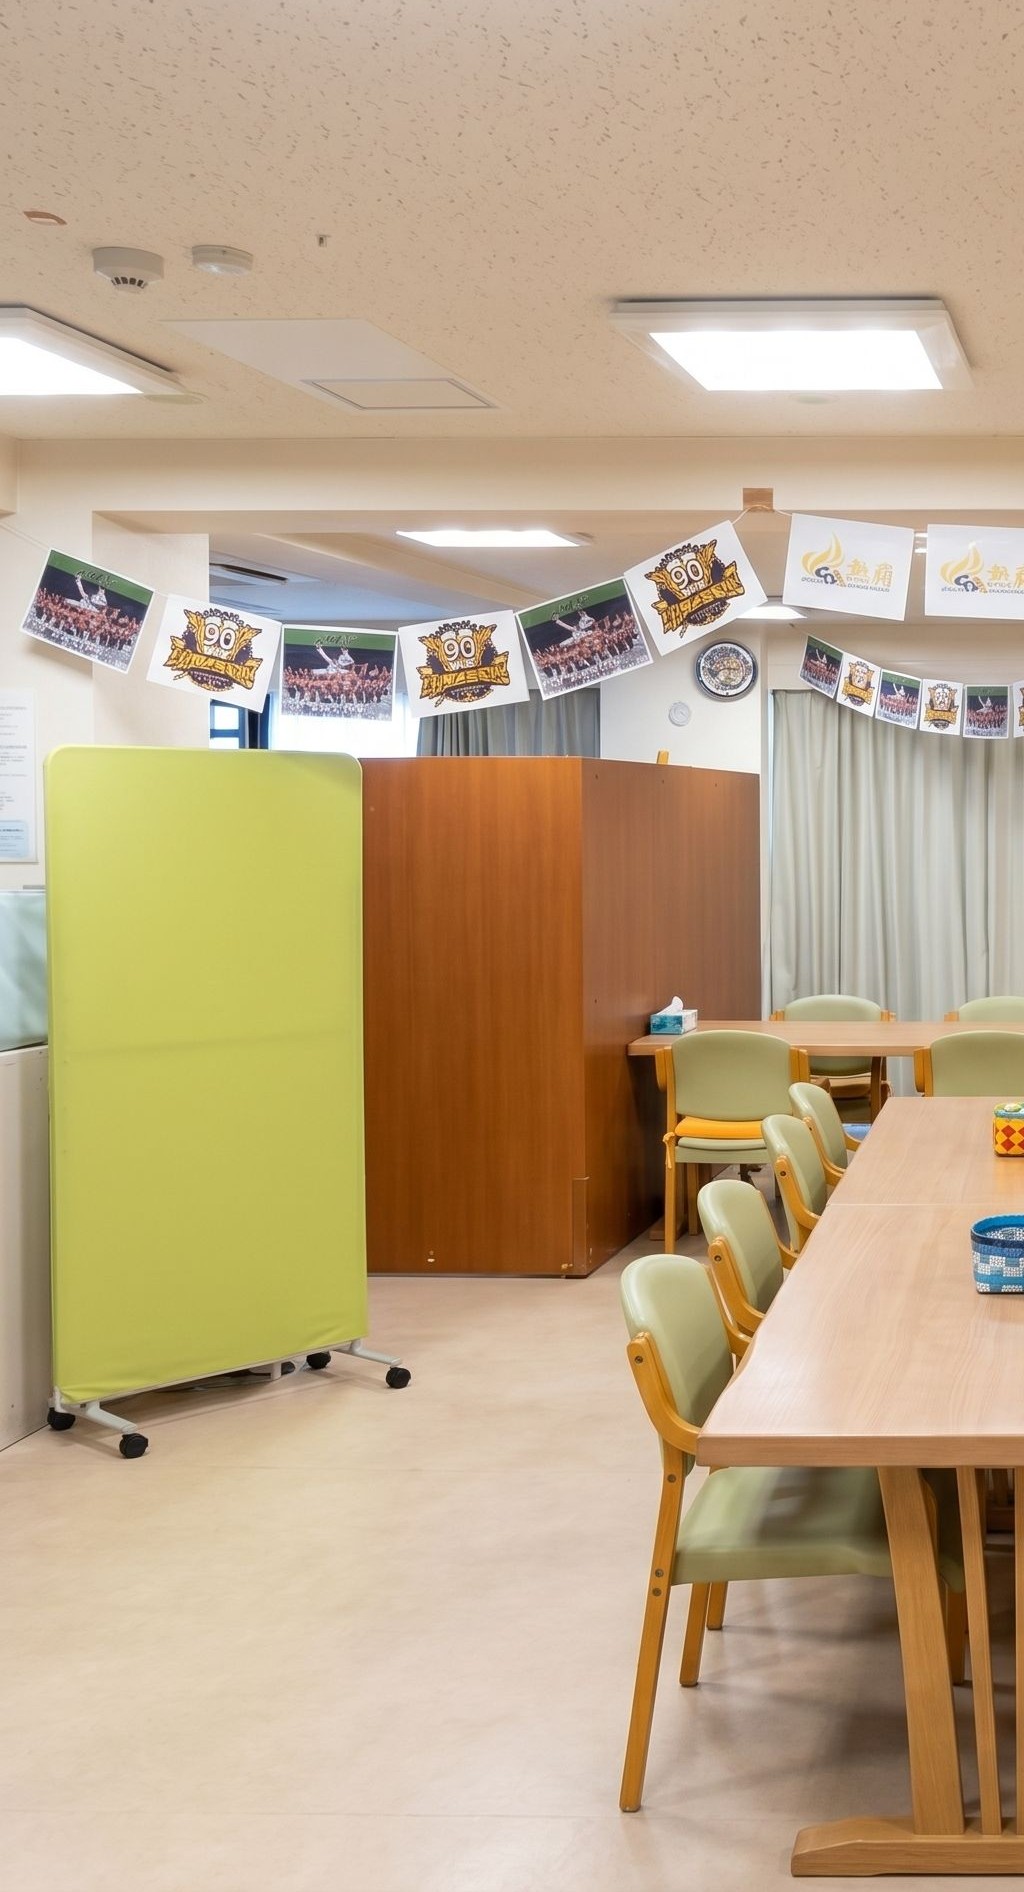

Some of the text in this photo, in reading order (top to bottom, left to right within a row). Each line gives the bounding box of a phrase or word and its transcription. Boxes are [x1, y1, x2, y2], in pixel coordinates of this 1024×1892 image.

[671, 559, 704, 589] 90
[203, 623, 236, 650] 90
[443, 636, 475, 661] 90
